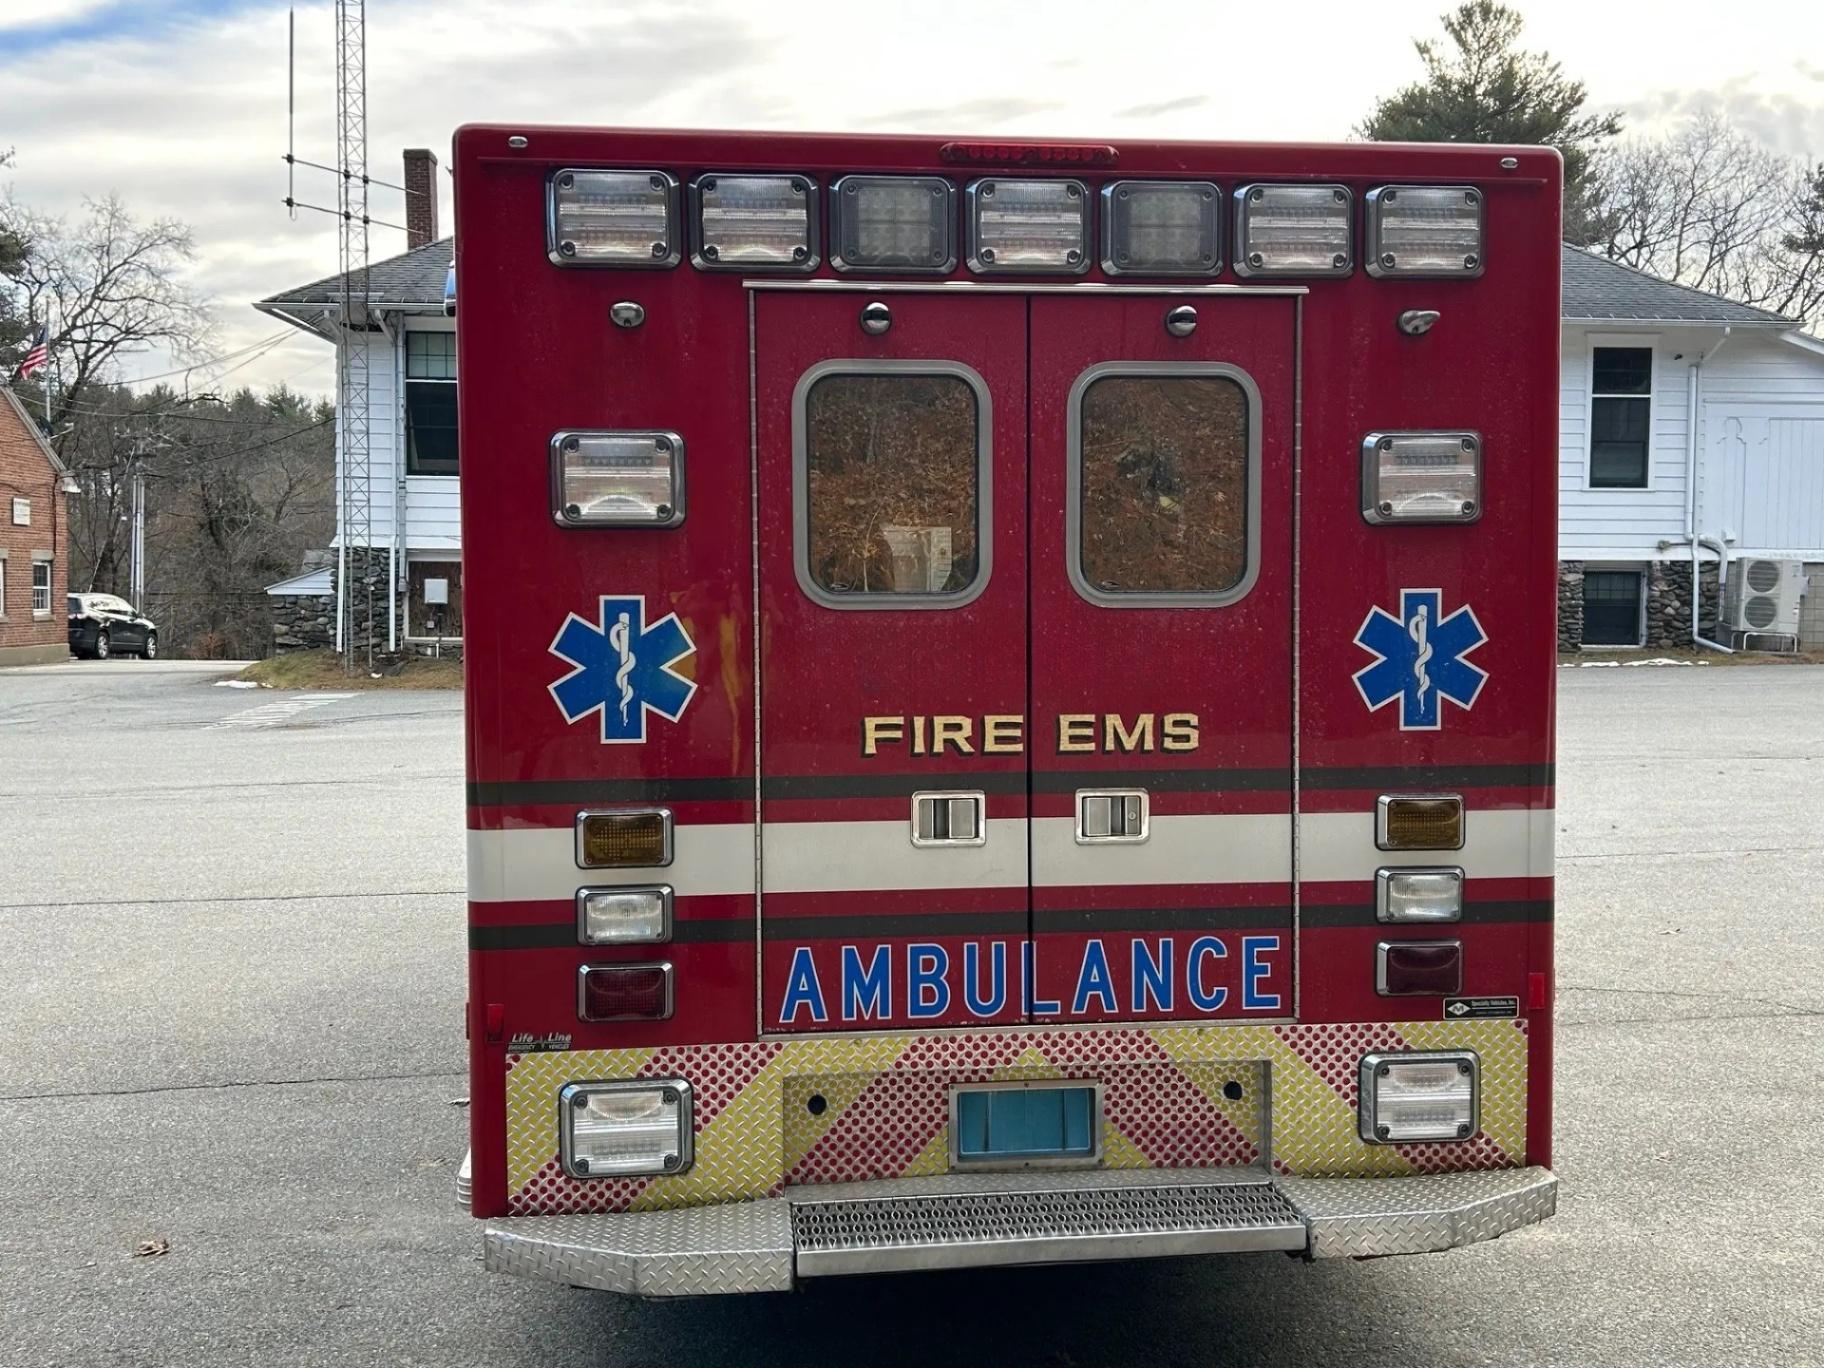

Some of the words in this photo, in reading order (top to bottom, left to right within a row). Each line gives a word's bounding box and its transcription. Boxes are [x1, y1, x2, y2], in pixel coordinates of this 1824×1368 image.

[862, 715, 1024, 757] FIRE
[1057, 713, 1200, 754] EMS
[779, 936, 1281, 1023] AMBULANCE
[511, 1032, 533, 1043] Life
[547, 1032, 572, 1042] Line
